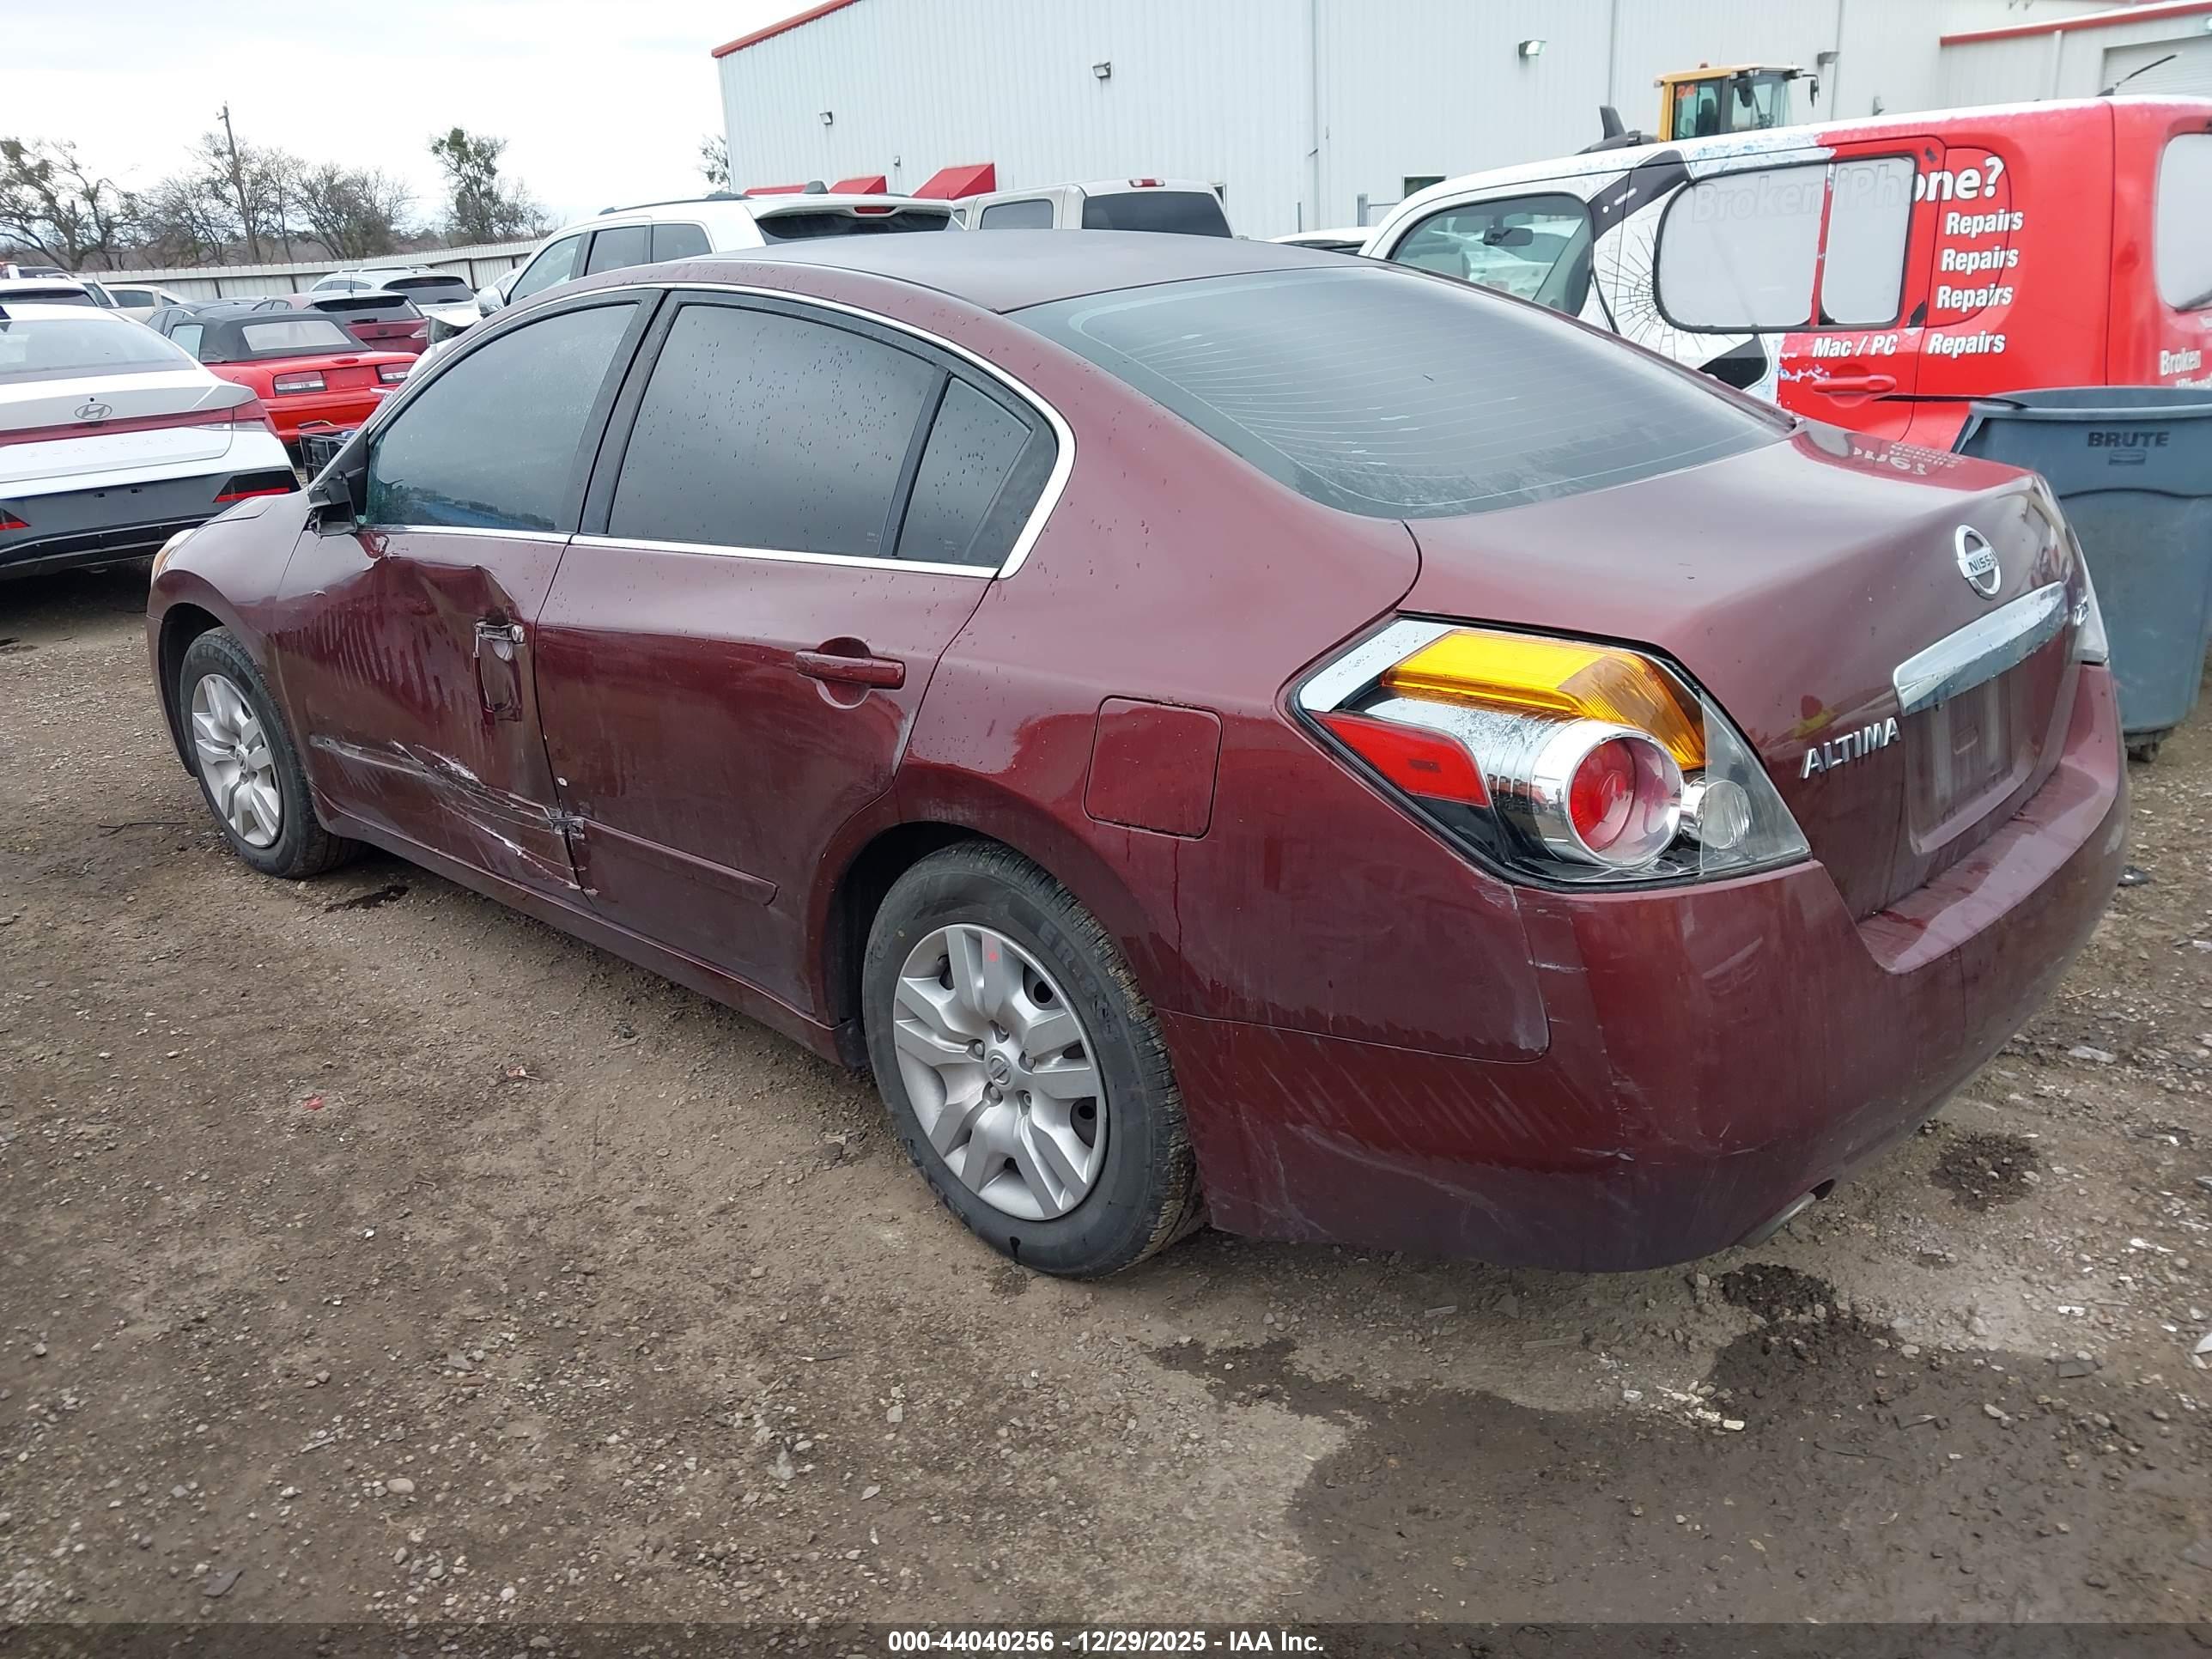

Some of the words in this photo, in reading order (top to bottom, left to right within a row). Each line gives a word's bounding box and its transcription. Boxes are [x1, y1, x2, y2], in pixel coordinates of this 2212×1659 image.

[1692, 175, 1824, 223] Broken
[1945, 208, 2024, 239] Repairs
[1941, 245, 2019, 276] Repairs
[1936, 283, 2014, 313] Repairs
[1812, 337, 1852, 358] Mac
[1855, 335, 1869, 357] /
[1869, 334, 1899, 356] PC
[1927, 330, 2006, 359] Repairs
[2087, 431, 2170, 447] BRUTE
[1967, 552, 1995, 573] NISS
[1800, 717, 1900, 779] ALTIMA
